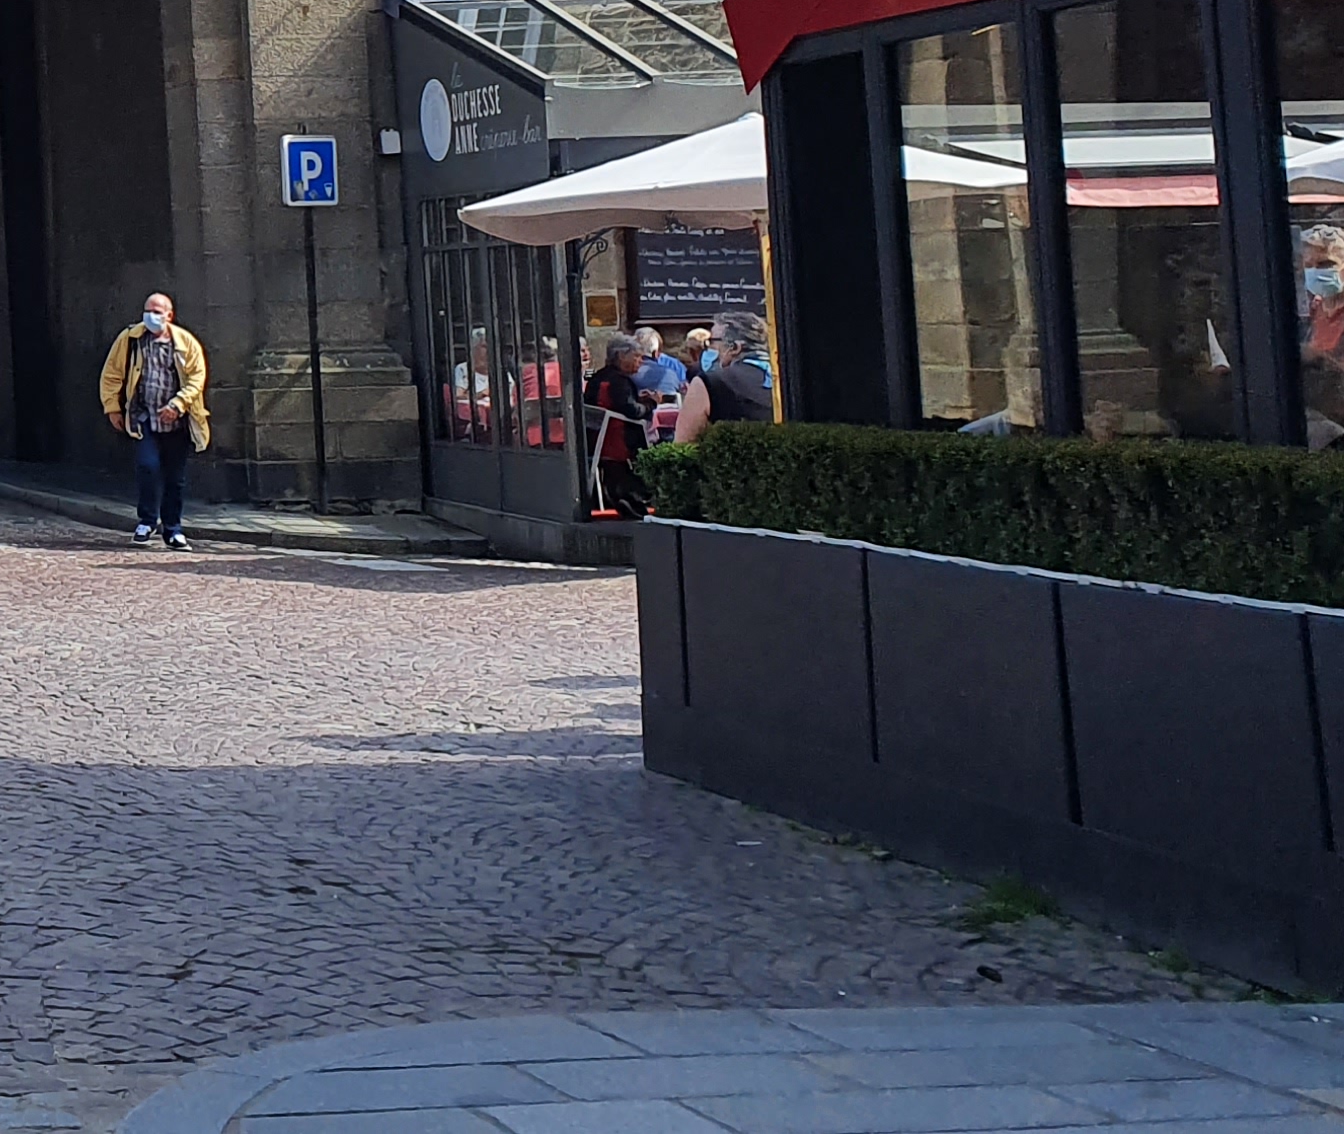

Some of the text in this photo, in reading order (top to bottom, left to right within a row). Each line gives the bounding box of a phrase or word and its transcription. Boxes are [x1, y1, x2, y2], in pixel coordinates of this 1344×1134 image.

[452, 84, 501, 122] DUCHESSE
[455, 122, 479, 154] ANNE
[300, 151, 322, 191] P
